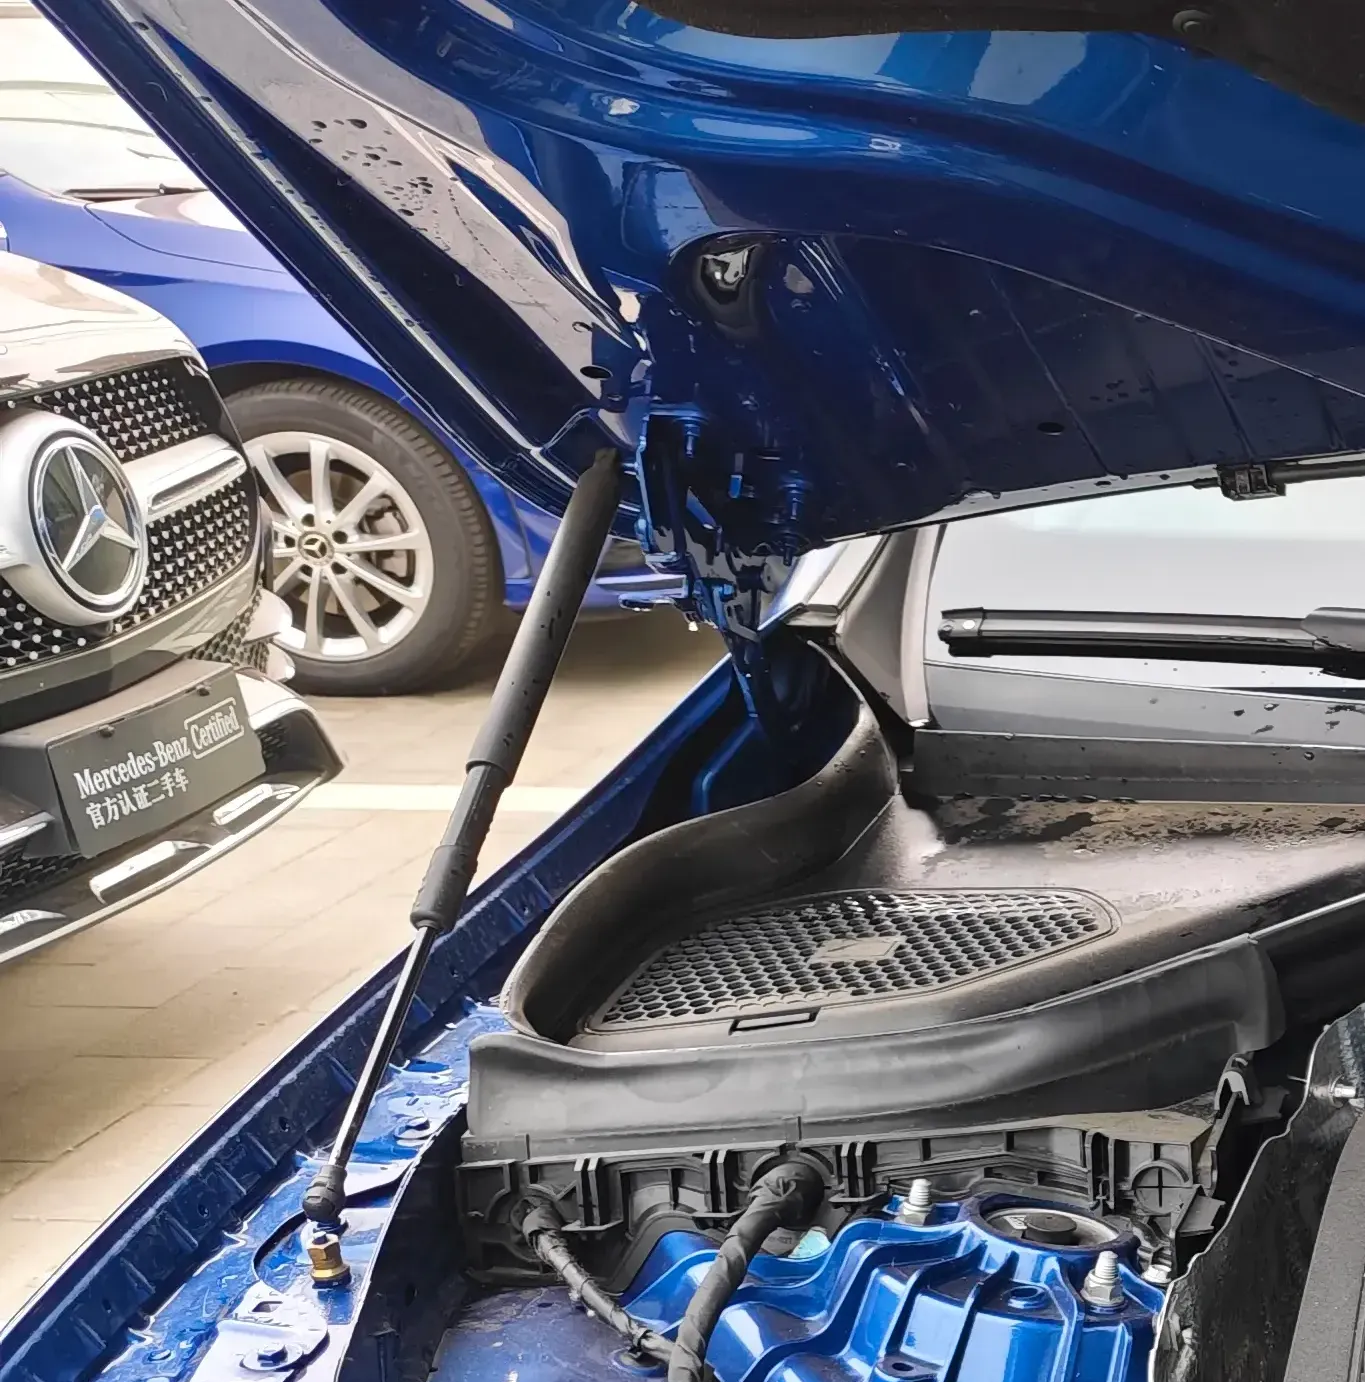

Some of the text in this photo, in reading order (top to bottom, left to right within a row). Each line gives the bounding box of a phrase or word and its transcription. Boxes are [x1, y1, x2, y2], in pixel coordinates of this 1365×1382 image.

[73, 704, 241, 800] Mercedes-Benz Certified
[86, 767, 189, 830] 官方认证二手车
